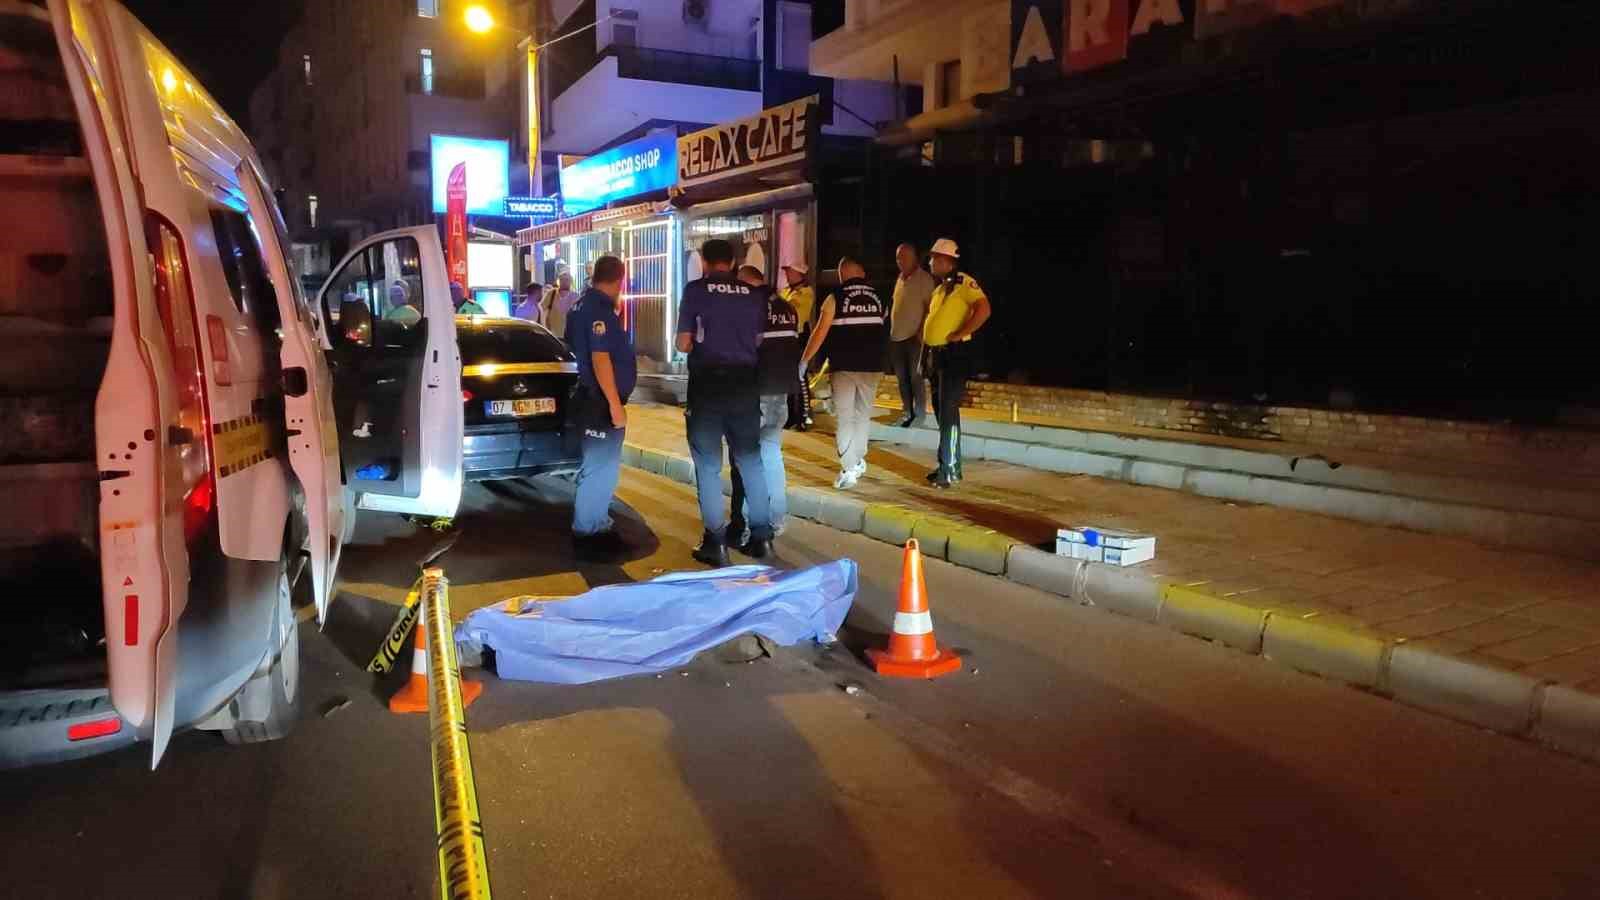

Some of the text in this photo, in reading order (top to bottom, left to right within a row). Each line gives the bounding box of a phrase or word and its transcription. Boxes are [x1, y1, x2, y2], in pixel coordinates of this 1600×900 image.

[680, 124, 740, 177] RELAX
[635, 148, 660, 172] SHOP
[508, 202, 553, 213] TABACCO
[492, 401, 505, 413] 07
